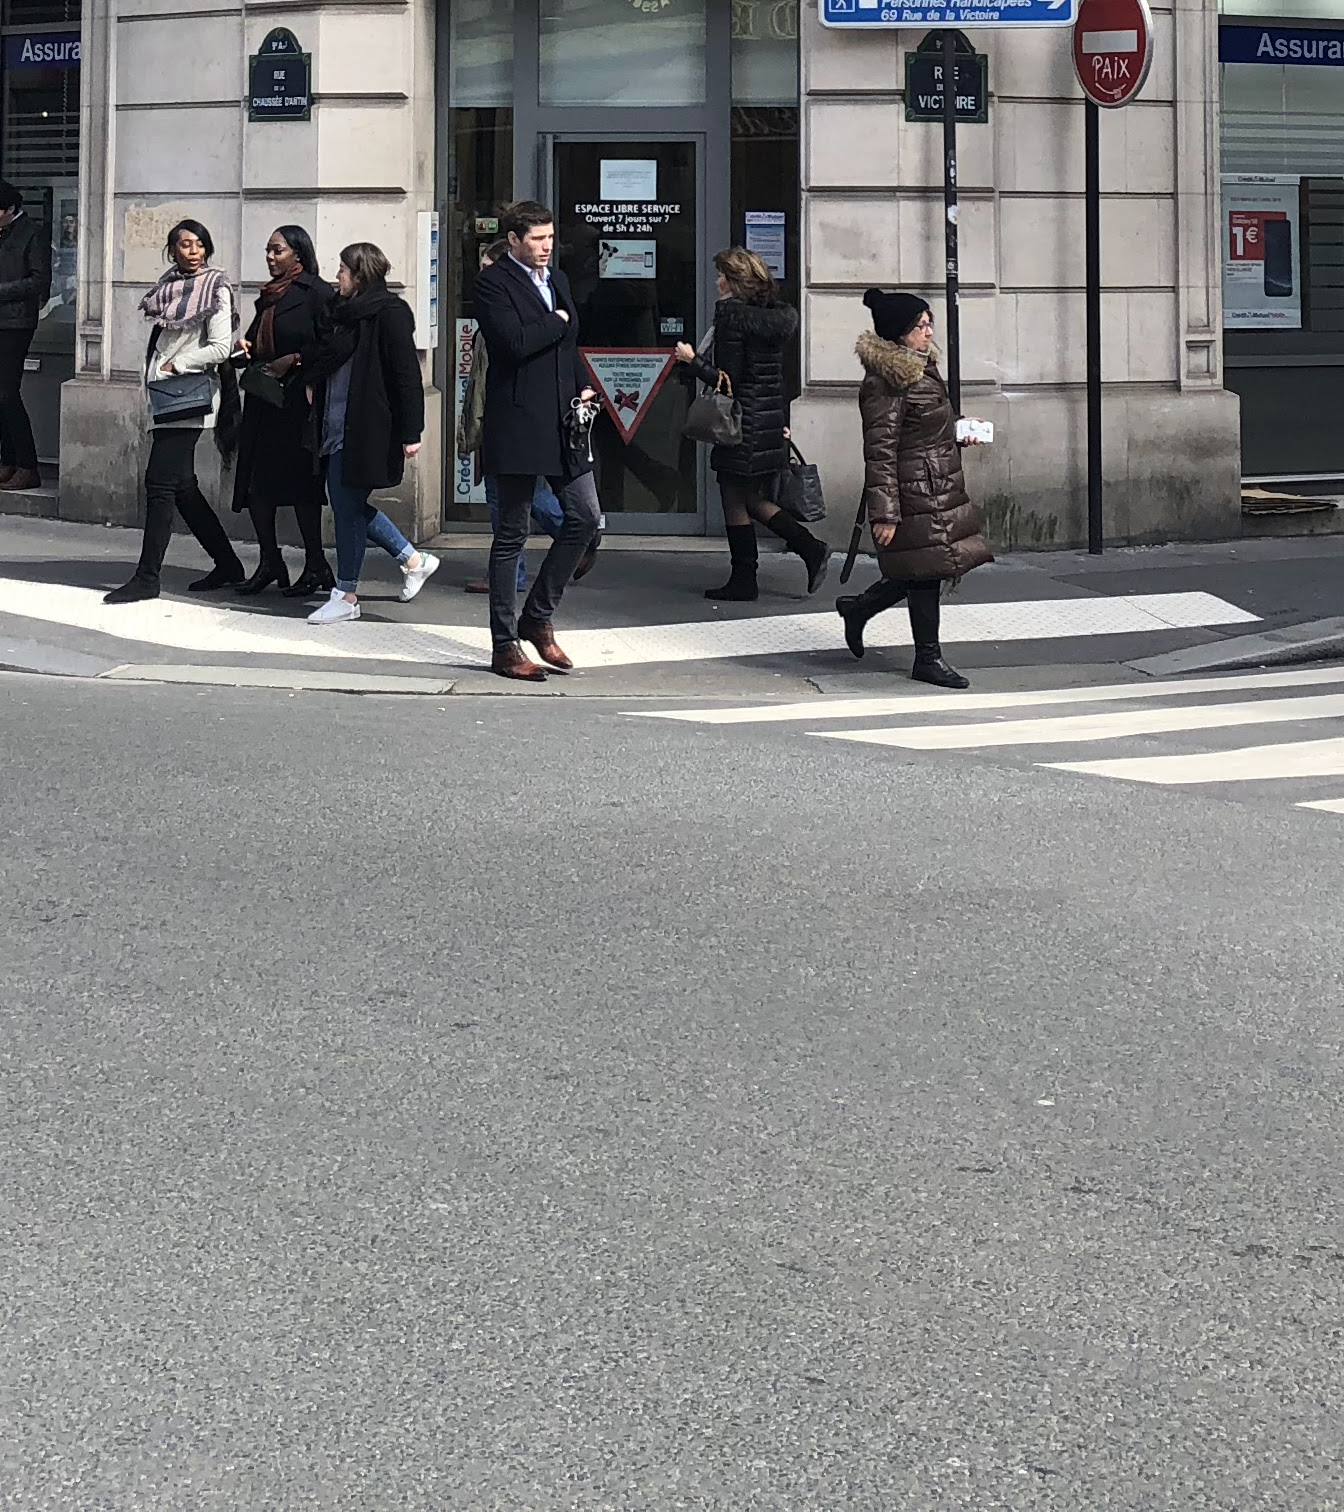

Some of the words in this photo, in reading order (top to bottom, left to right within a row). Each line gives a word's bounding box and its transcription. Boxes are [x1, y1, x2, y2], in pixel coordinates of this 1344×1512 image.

[880, 9, 898, 21] 69
[902, 9, 923, 21] Rue
[926, 9, 941, 21] de
[945, 9, 956, 20] la
[959, 8, 1000, 20] Victoire
[273, 70, 286, 80] RUE
[933, 65, 960, 80] RE
[918, 94, 976, 110] VICTIRE
[575, 204, 611, 213] ESPACE
[613, 204, 639, 213] LIBRE
[641, 204, 681, 213] SERVICE
[585, 214, 616, 223] Ouvert
[617, 214, 623, 223] 7
[624, 214, 647, 224] jours
[664, 214, 670, 223] 7
[602, 224, 614, 233] de
[628, 224, 635, 233] à
[636, 224, 653, 233] 24h
